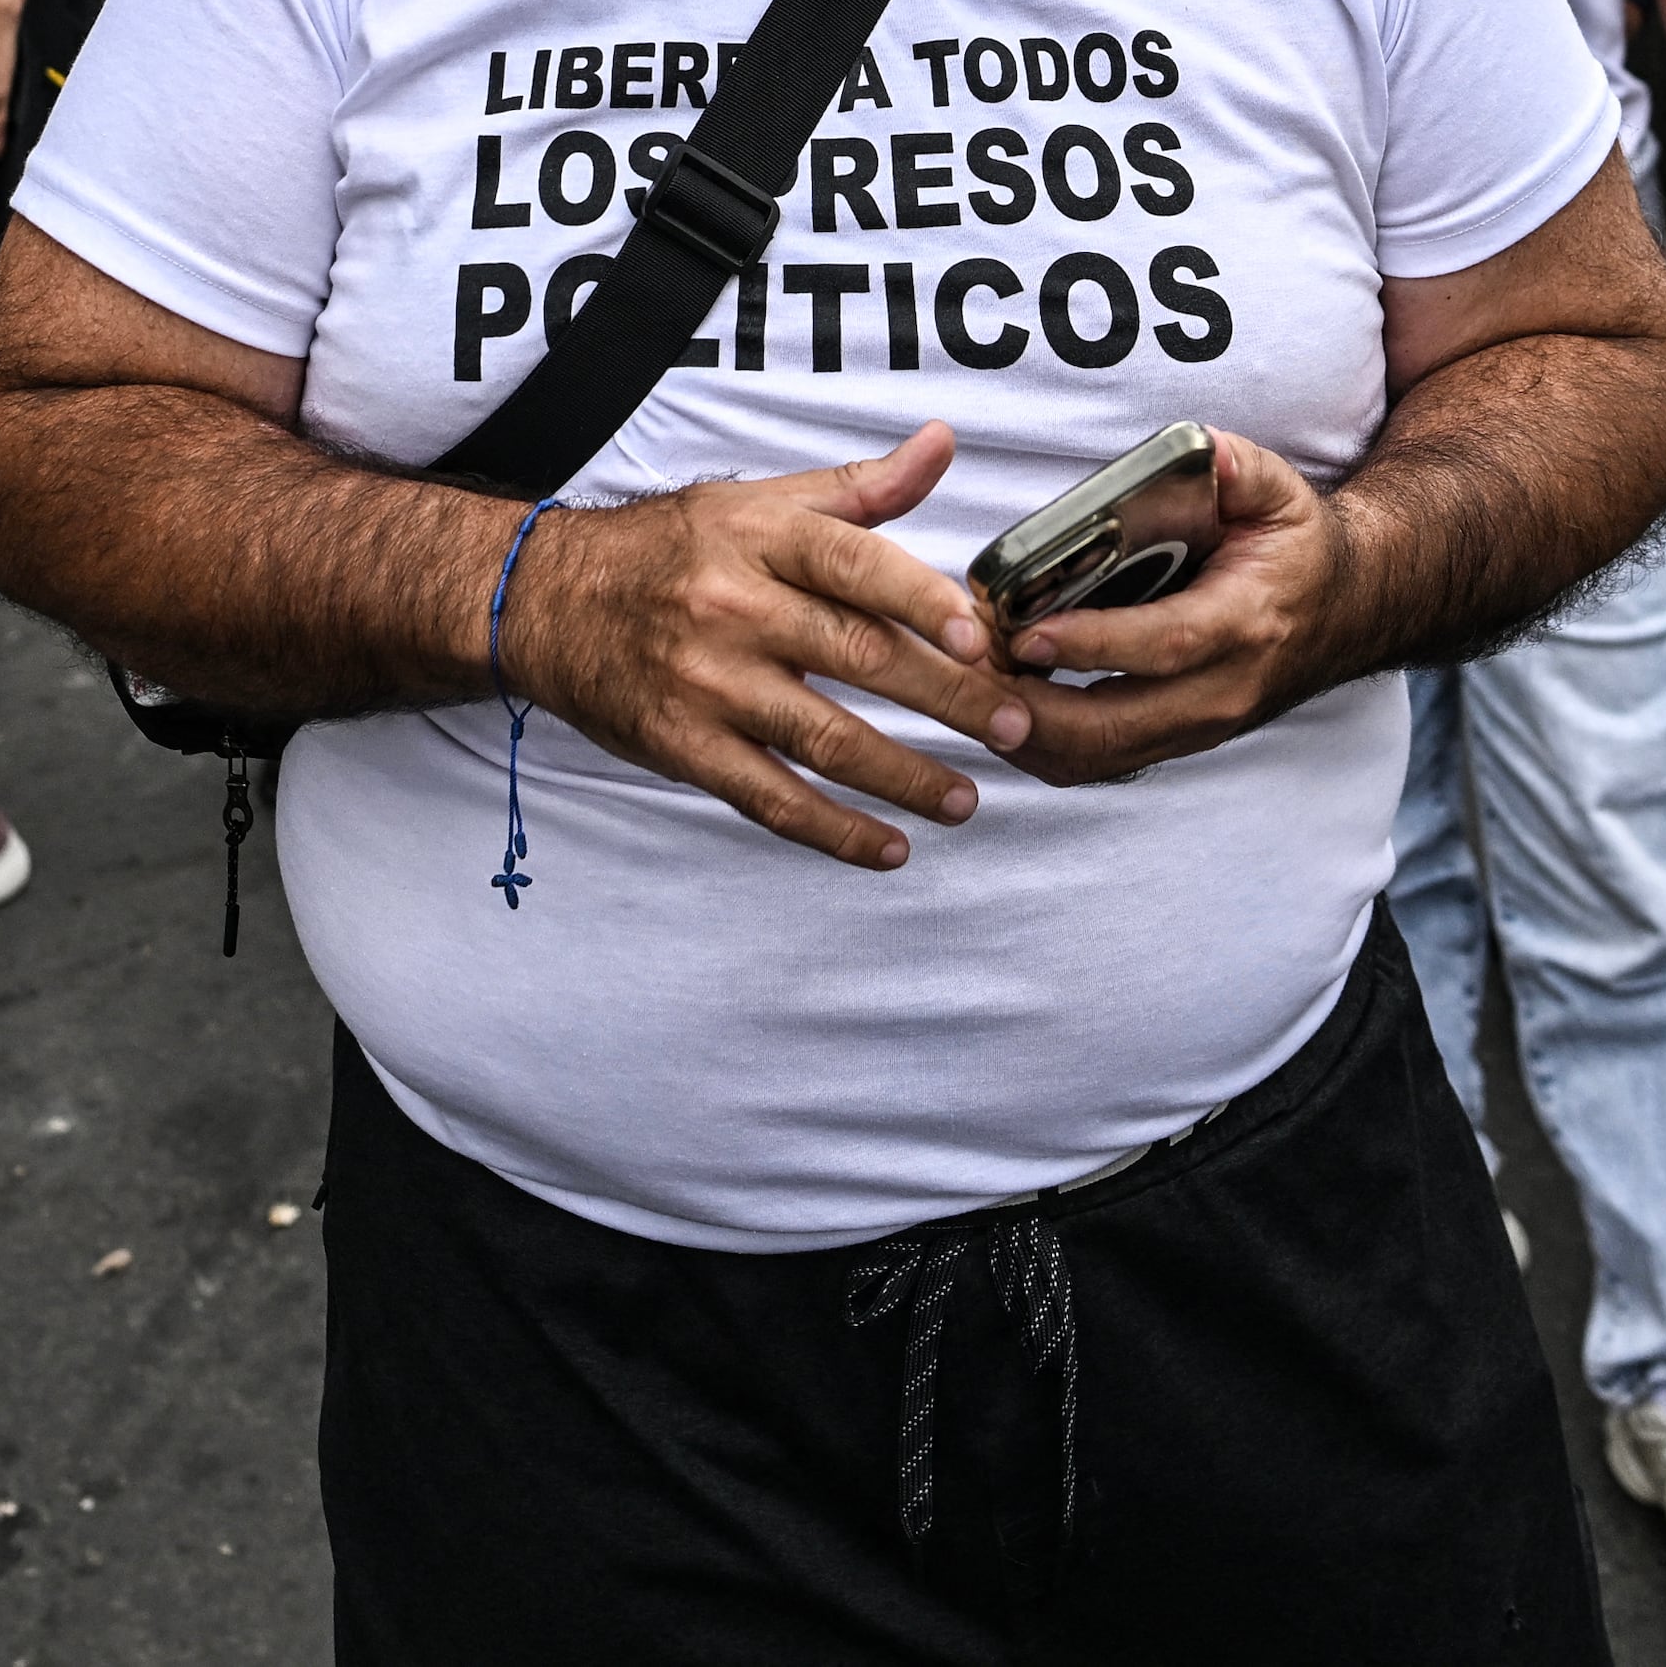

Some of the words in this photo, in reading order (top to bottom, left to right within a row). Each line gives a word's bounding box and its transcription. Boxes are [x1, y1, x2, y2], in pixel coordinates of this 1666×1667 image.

[837, 46, 893, 113] A
[912, 29, 1180, 109] TODOS
[773, 122, 1196, 233] RESOS
[453, 245, 1234, 383] PITICOS
